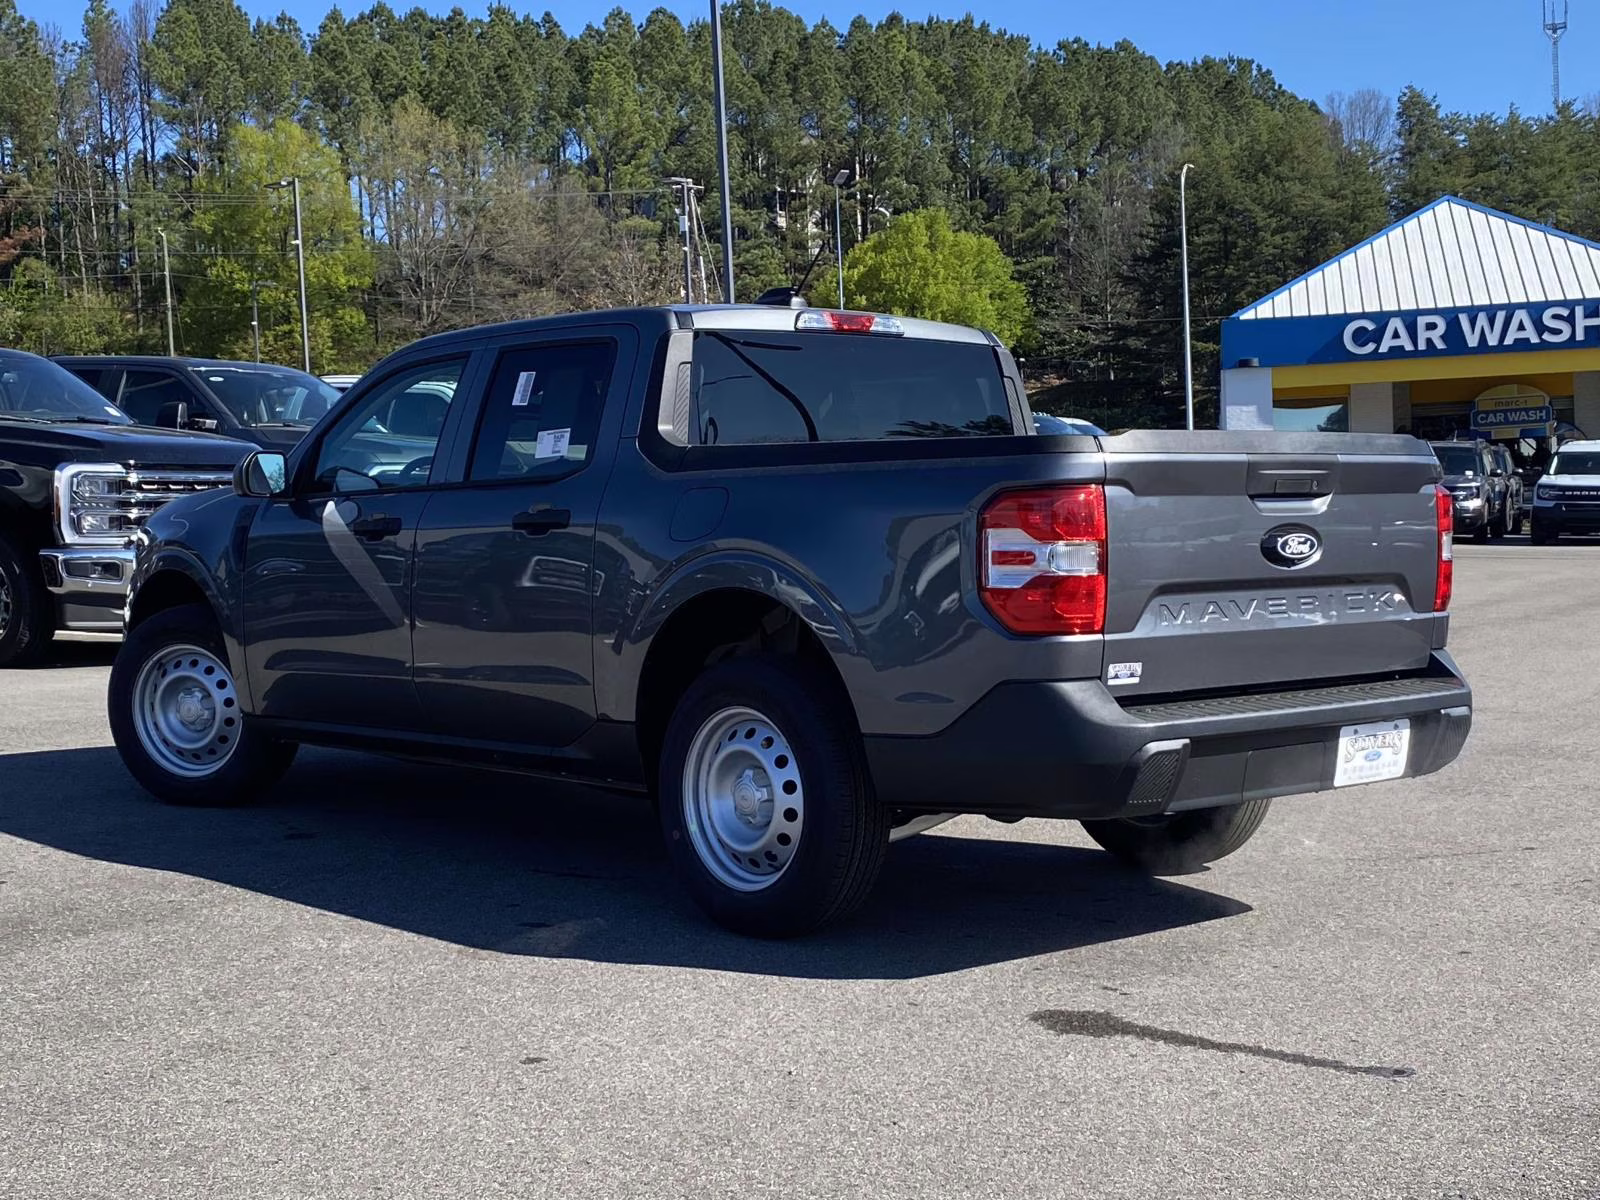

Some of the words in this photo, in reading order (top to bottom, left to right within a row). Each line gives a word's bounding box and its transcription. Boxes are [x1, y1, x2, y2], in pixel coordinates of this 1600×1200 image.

[1343, 315, 1447, 355] CAR
[1458, 304, 1600, 348] WASH
[1477, 413, 1505, 424] CAR
[1507, 410, 1546, 421] WASH
[1158, 591, 1395, 626] MAVERICK
